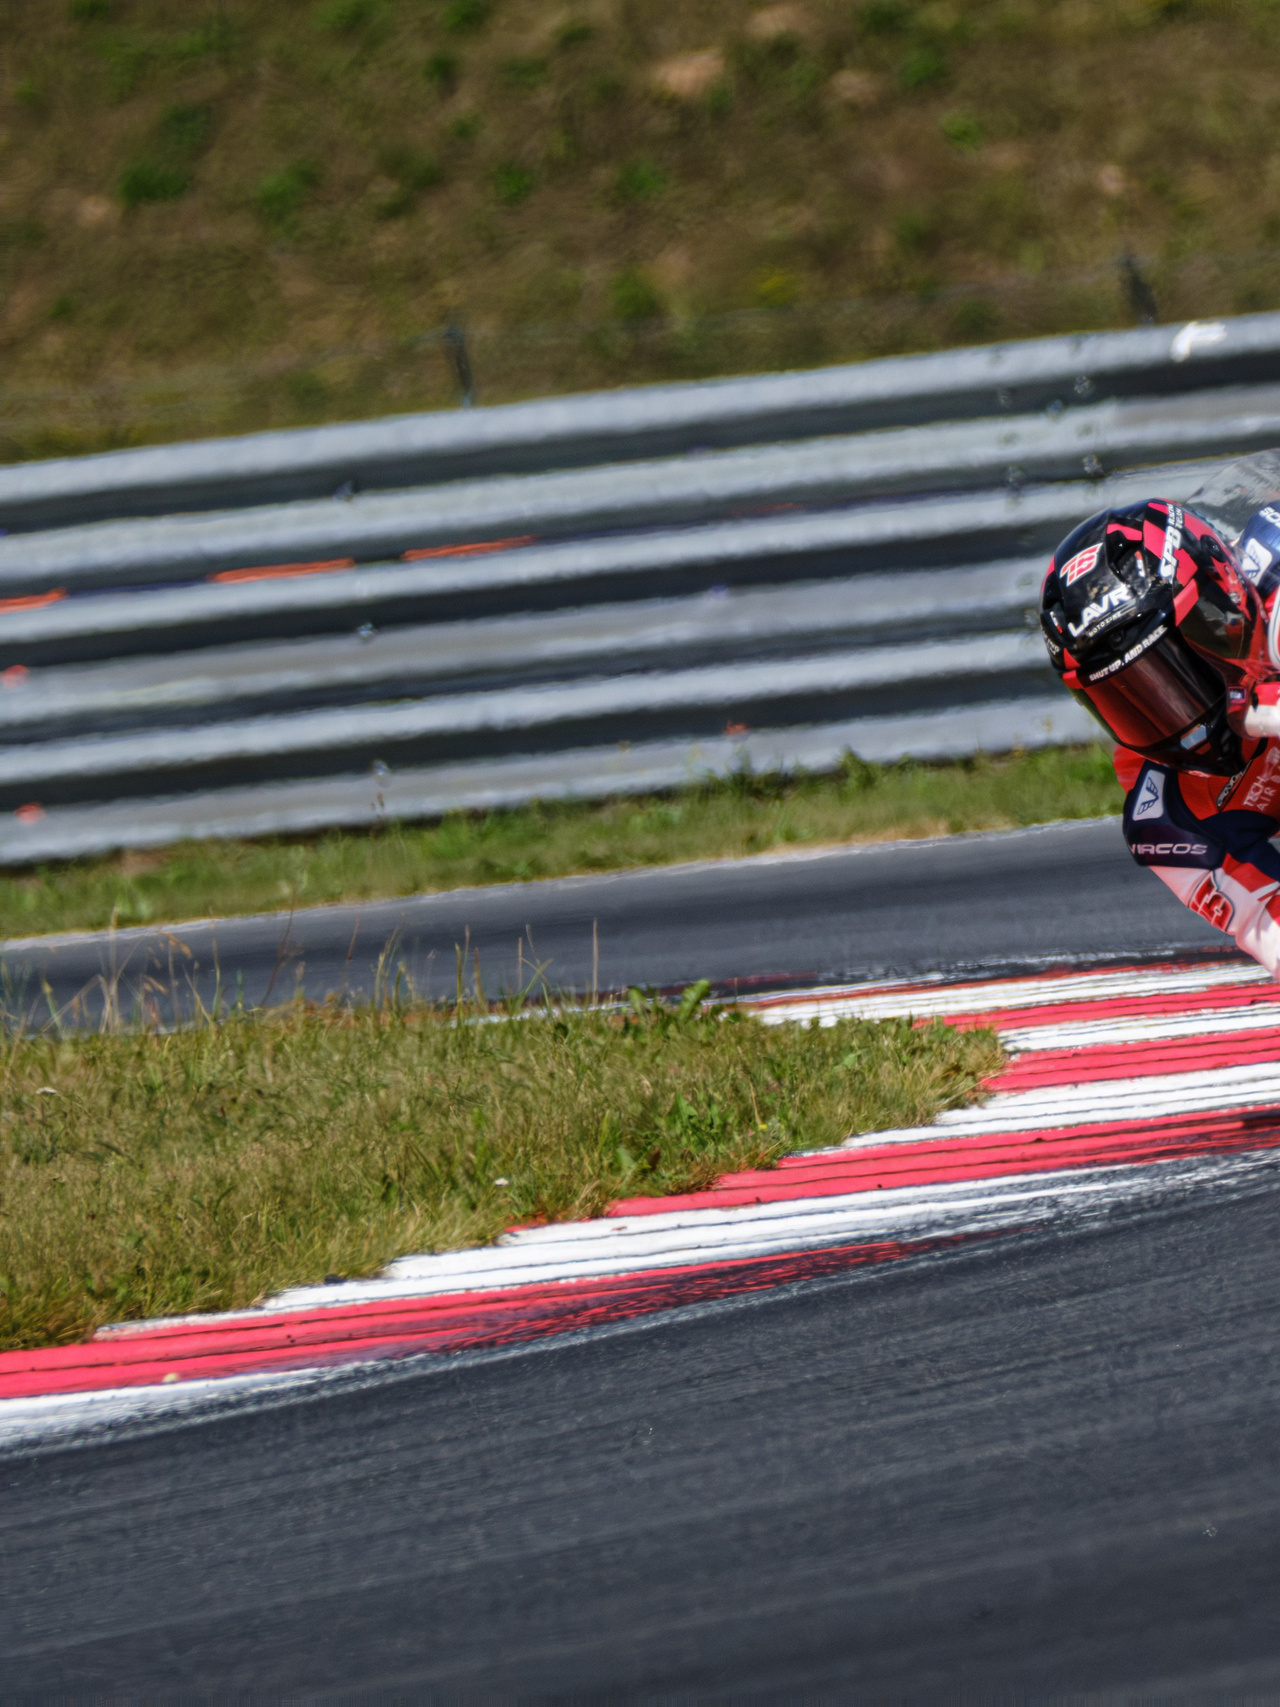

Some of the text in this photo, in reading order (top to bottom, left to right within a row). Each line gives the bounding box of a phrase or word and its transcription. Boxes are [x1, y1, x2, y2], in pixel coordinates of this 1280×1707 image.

[1160, 525, 1182, 584] SPB
[1067, 581, 1132, 637] LAVR
[1089, 667, 1109, 682] SHUT
[1124, 643, 1144, 664] AND
